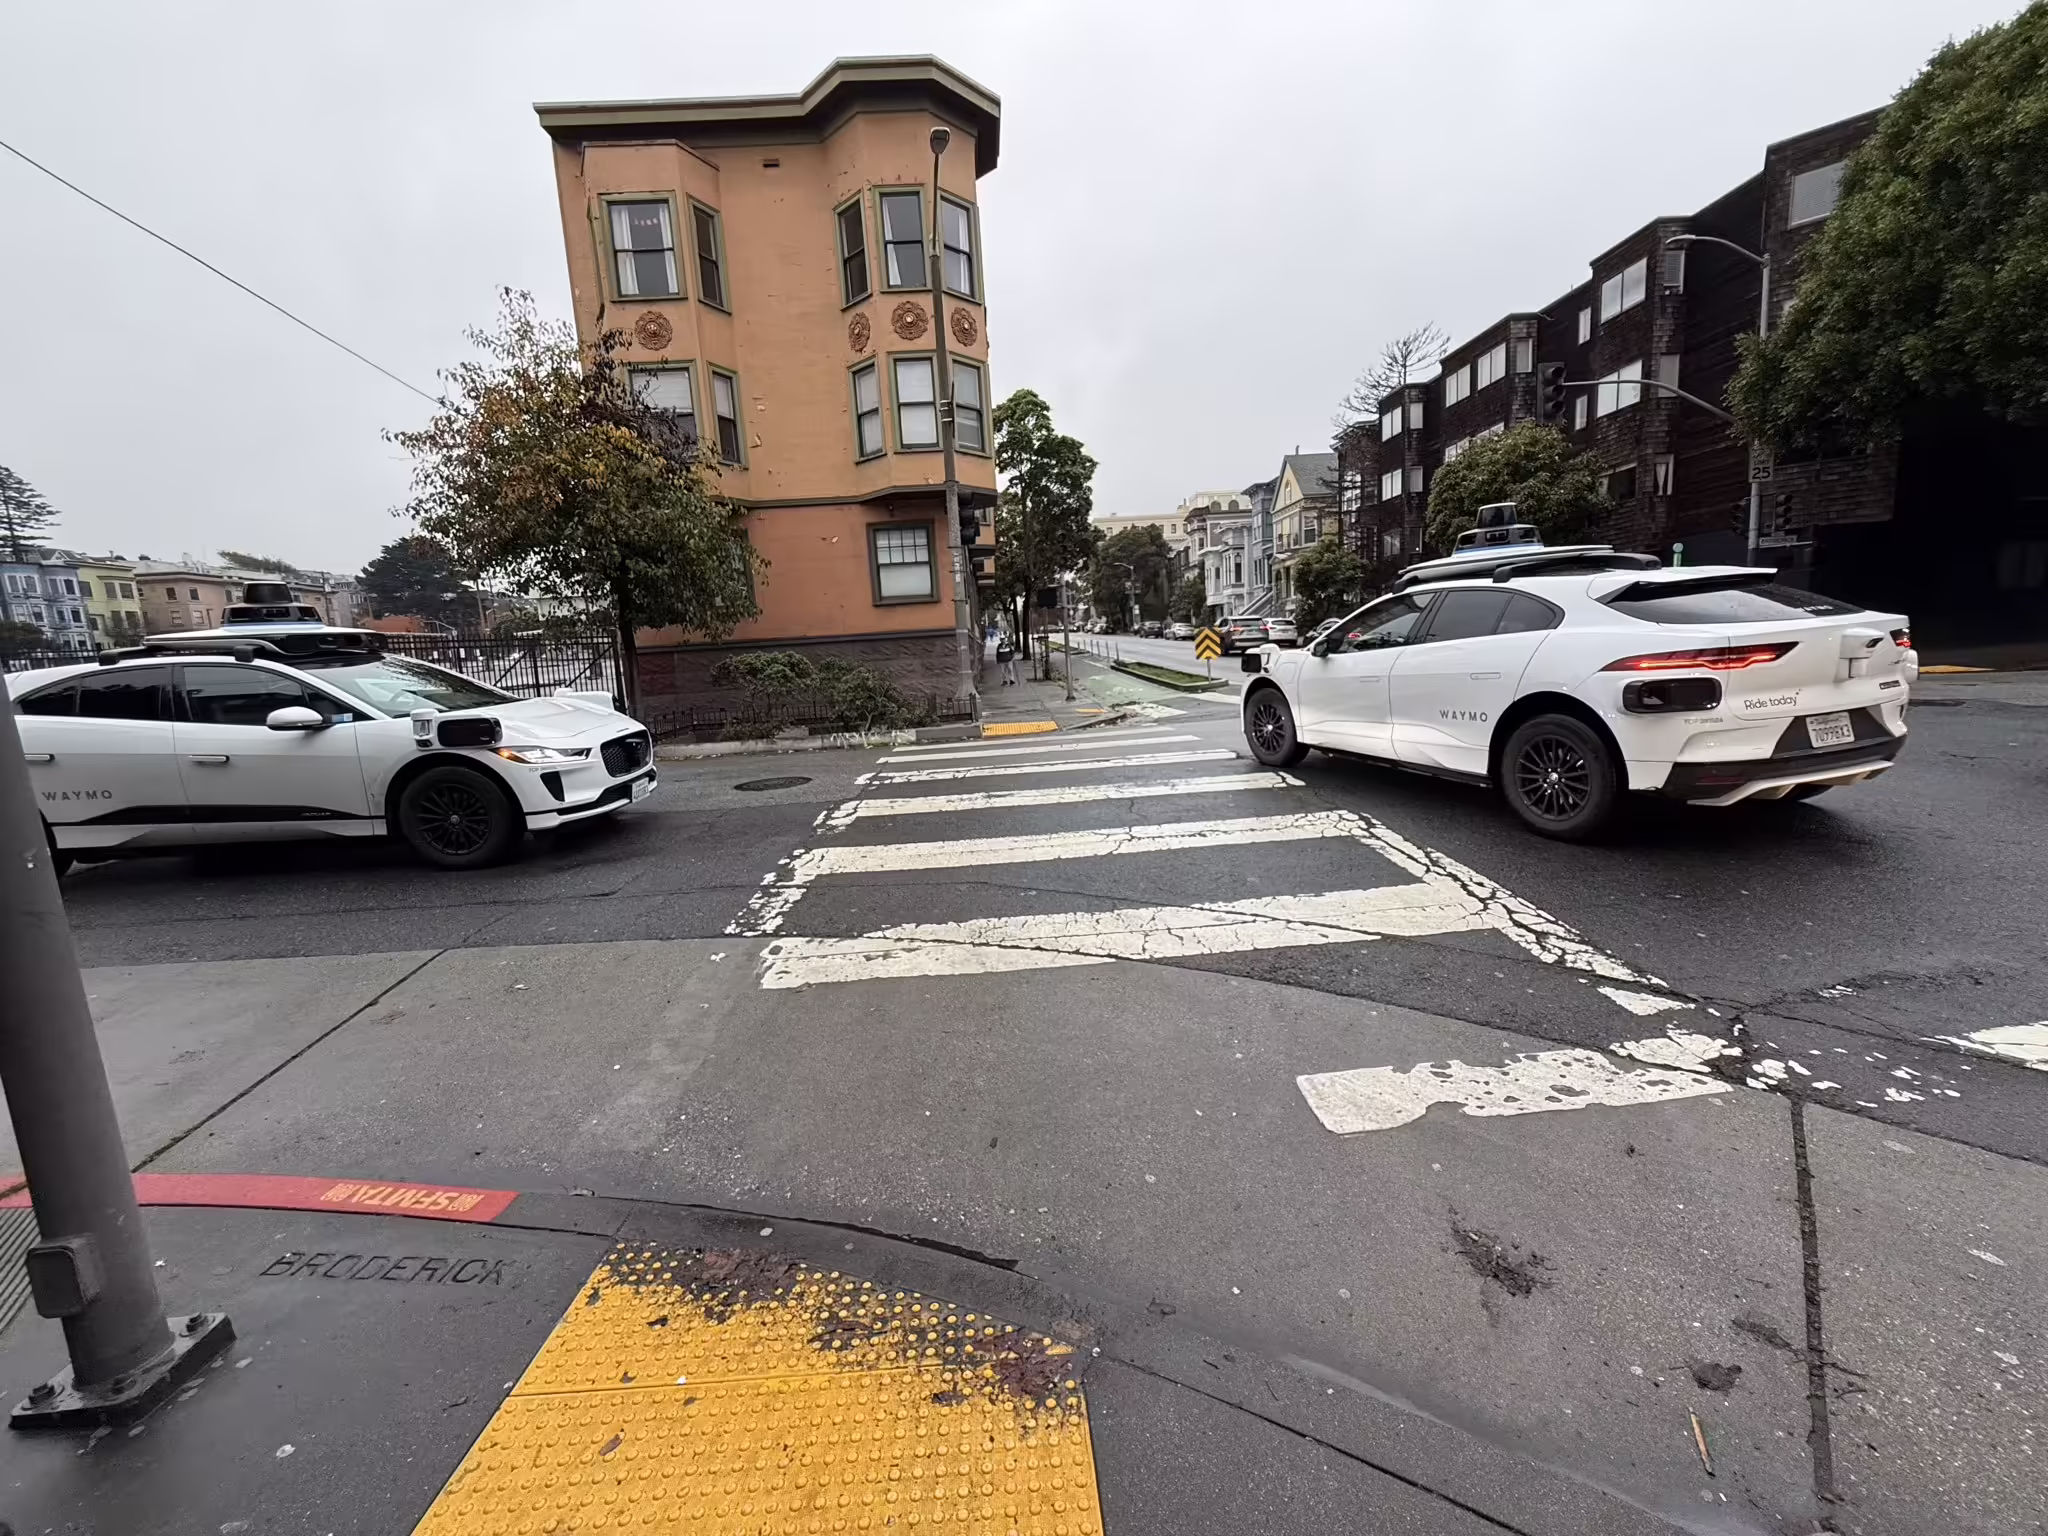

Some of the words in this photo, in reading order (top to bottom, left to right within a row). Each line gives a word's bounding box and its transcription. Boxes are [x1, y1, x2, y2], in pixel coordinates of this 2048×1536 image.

[1752, 466, 1771, 480] 25
[1744, 698, 1768, 710] Ride
[1769, 695, 1797, 706] today
[1439, 709, 1488, 722] WAYMO
[41, 789, 112, 801] WAYMO
[351, 1185, 460, 1211] SFMTA
[259, 1252, 506, 1285] BRODERICK
